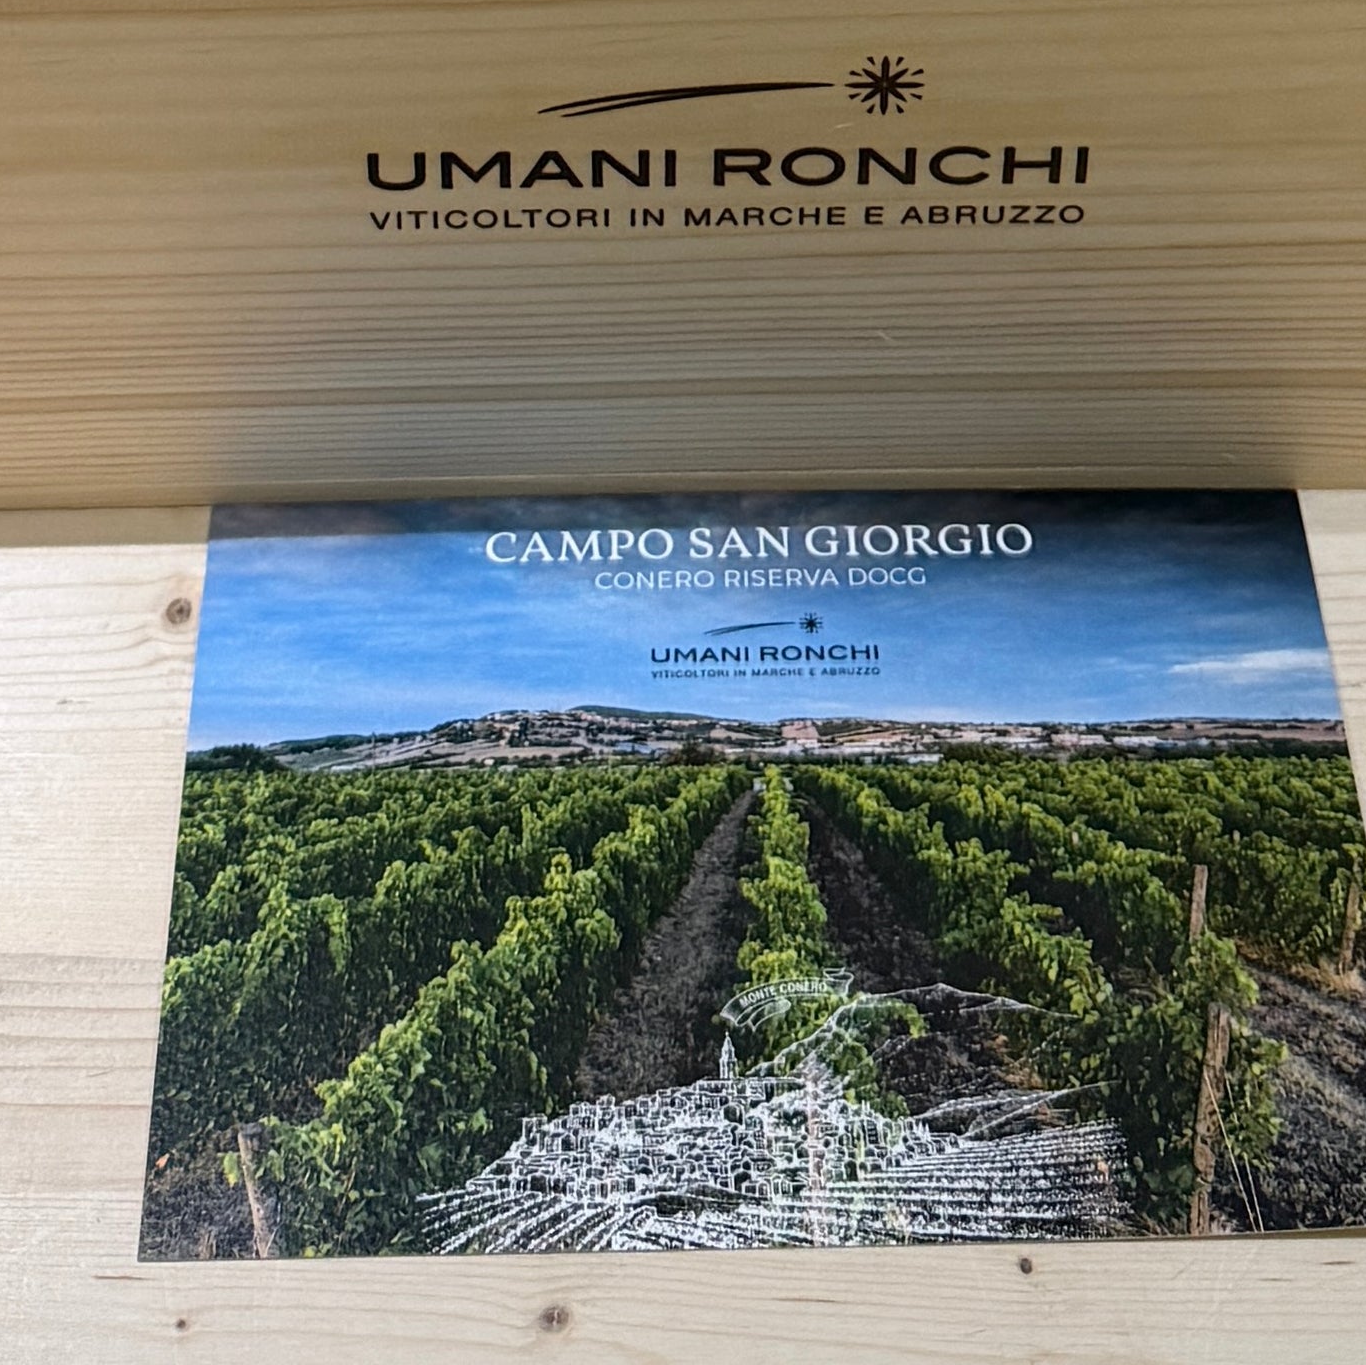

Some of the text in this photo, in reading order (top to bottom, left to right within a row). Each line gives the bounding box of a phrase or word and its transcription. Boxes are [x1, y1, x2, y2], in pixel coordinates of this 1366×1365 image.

[366, 146, 1090, 191] UMANI RONCHI
[369, 204, 1085, 231] VITICOLTORI IN MARCHE E ABRUZZO
[485, 522, 1034, 564] CAMPO SAN GIORGIO
[594, 566, 927, 591] CONERO RISERVA DOCG
[650, 645, 880, 663] UMANI RONCHI
[651, 669, 730, 679] VITICOLTORI
[735, 669, 747, 678] IN
[751, 668, 804, 678] MARCHE
[820, 666, 881, 676] ABRUZZO
